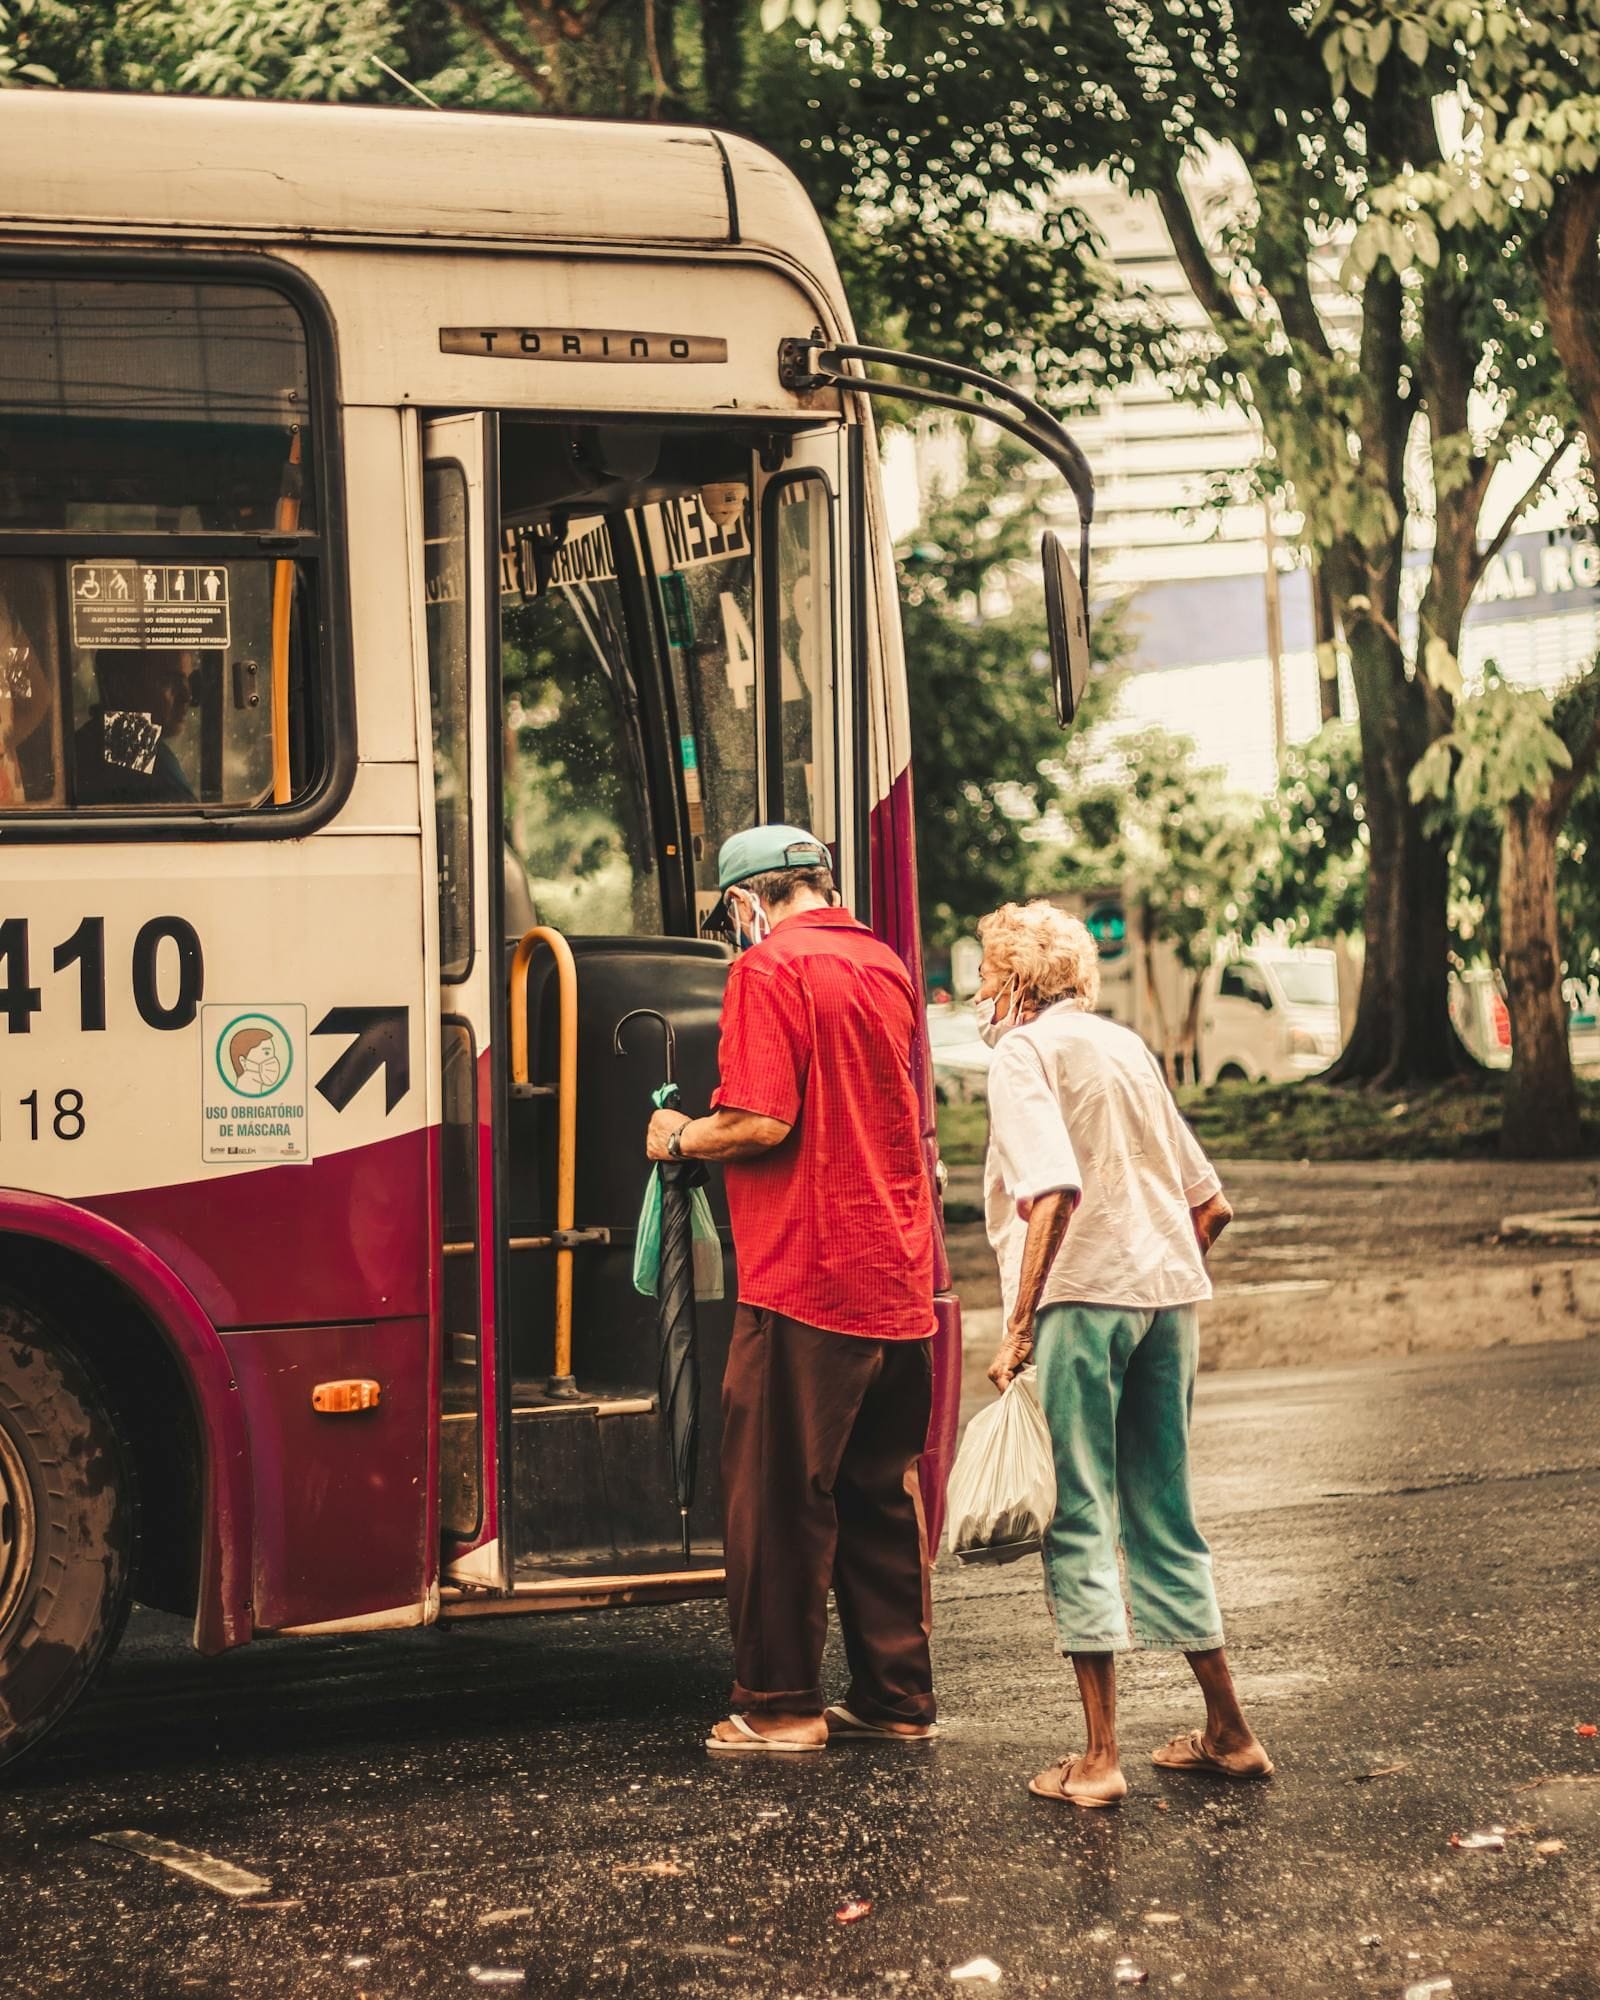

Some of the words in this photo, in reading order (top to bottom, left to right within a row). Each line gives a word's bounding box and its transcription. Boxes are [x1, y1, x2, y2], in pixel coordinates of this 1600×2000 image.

[480, 332, 690, 359] TORINO
[1471, 550, 1536, 602] AL
[0, 915, 205, 1034] 410
[0, 1088, 86, 1141] 18
[205, 1106, 228, 1120] USO
[231, 1102, 304, 1119] OBRIGATÓRIO
[219, 1124, 234, 1137] DE
[237, 1120, 292, 1137] MÁSCARA
